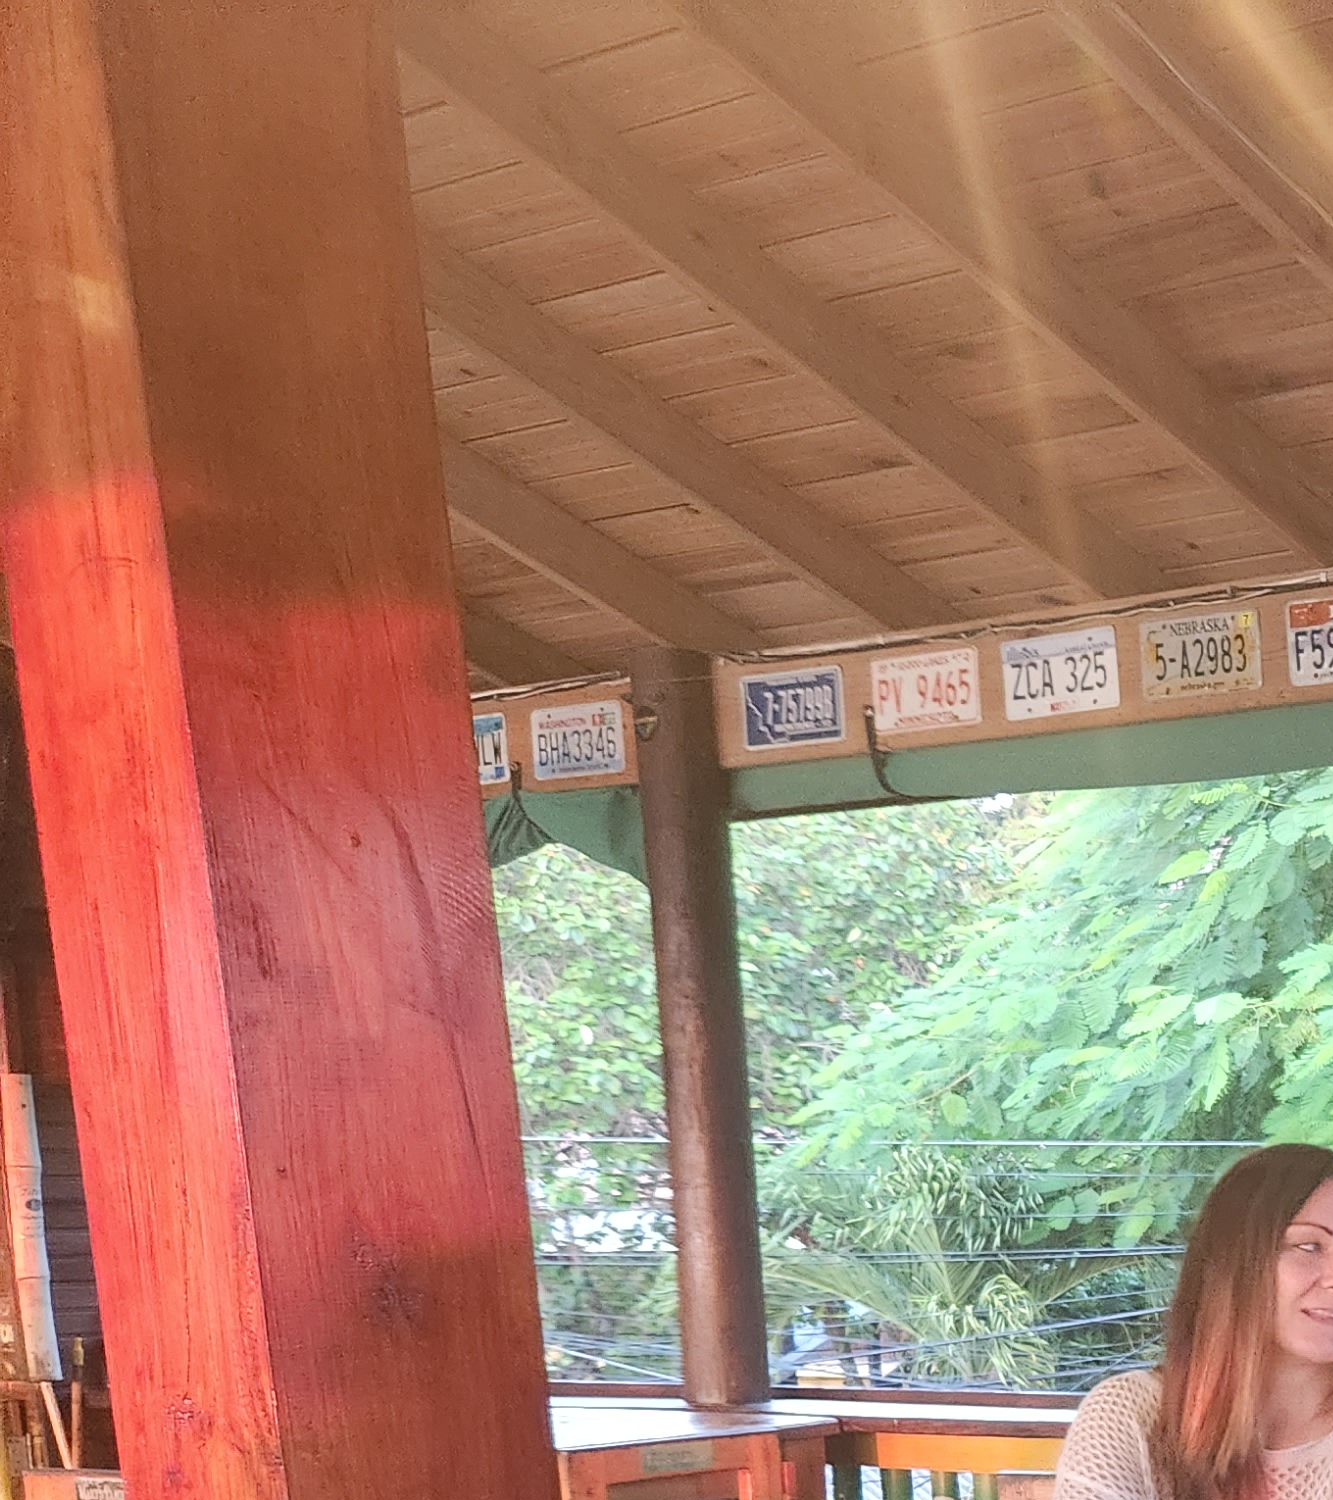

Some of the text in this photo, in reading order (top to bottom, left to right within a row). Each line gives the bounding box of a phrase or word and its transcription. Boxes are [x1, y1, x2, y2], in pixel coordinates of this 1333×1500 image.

[1170, 618, 1229, 637] NEBRASKA
[1010, 659, 1055, 700] ZCA
[1065, 650, 1107, 693] 325
[1155, 633, 1246, 681] 5-A2983
[916, 668, 971, 709] 9465
[537, 725, 617, 767] BHA3346
